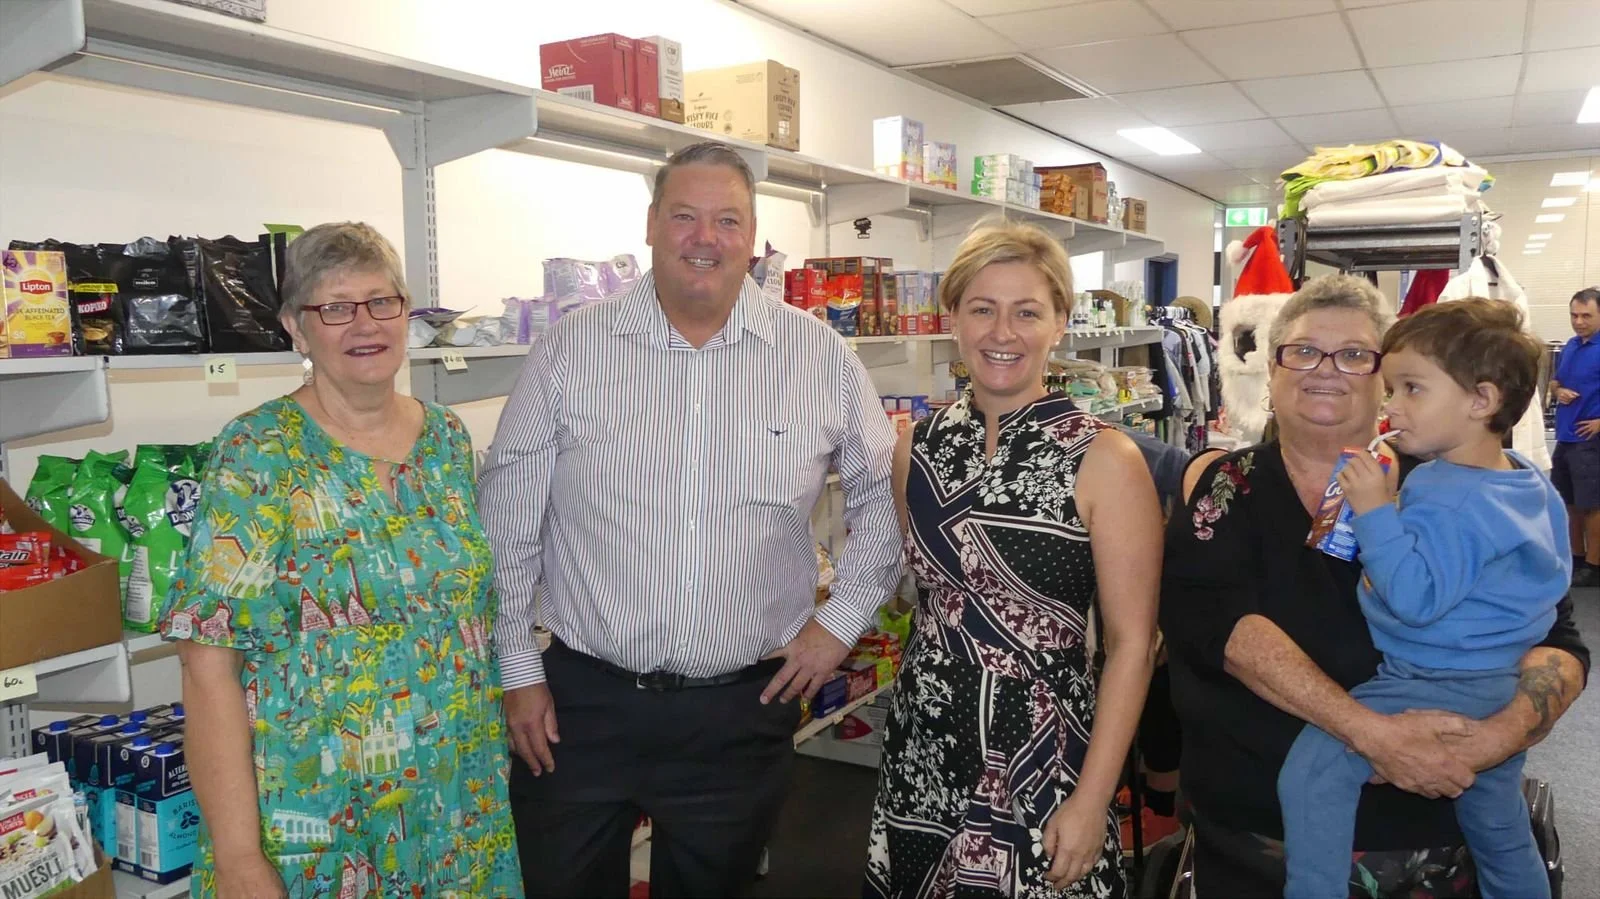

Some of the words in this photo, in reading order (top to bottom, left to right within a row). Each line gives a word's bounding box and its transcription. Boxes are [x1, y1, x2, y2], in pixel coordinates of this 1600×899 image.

[545, 64, 575, 79] Heinz
[686, 112, 705, 123] RISPY
[22, 283, 51, 292] Lipton
[173, 799, 198, 816] BARIS
[1, 858, 62, 899] MUESLI
